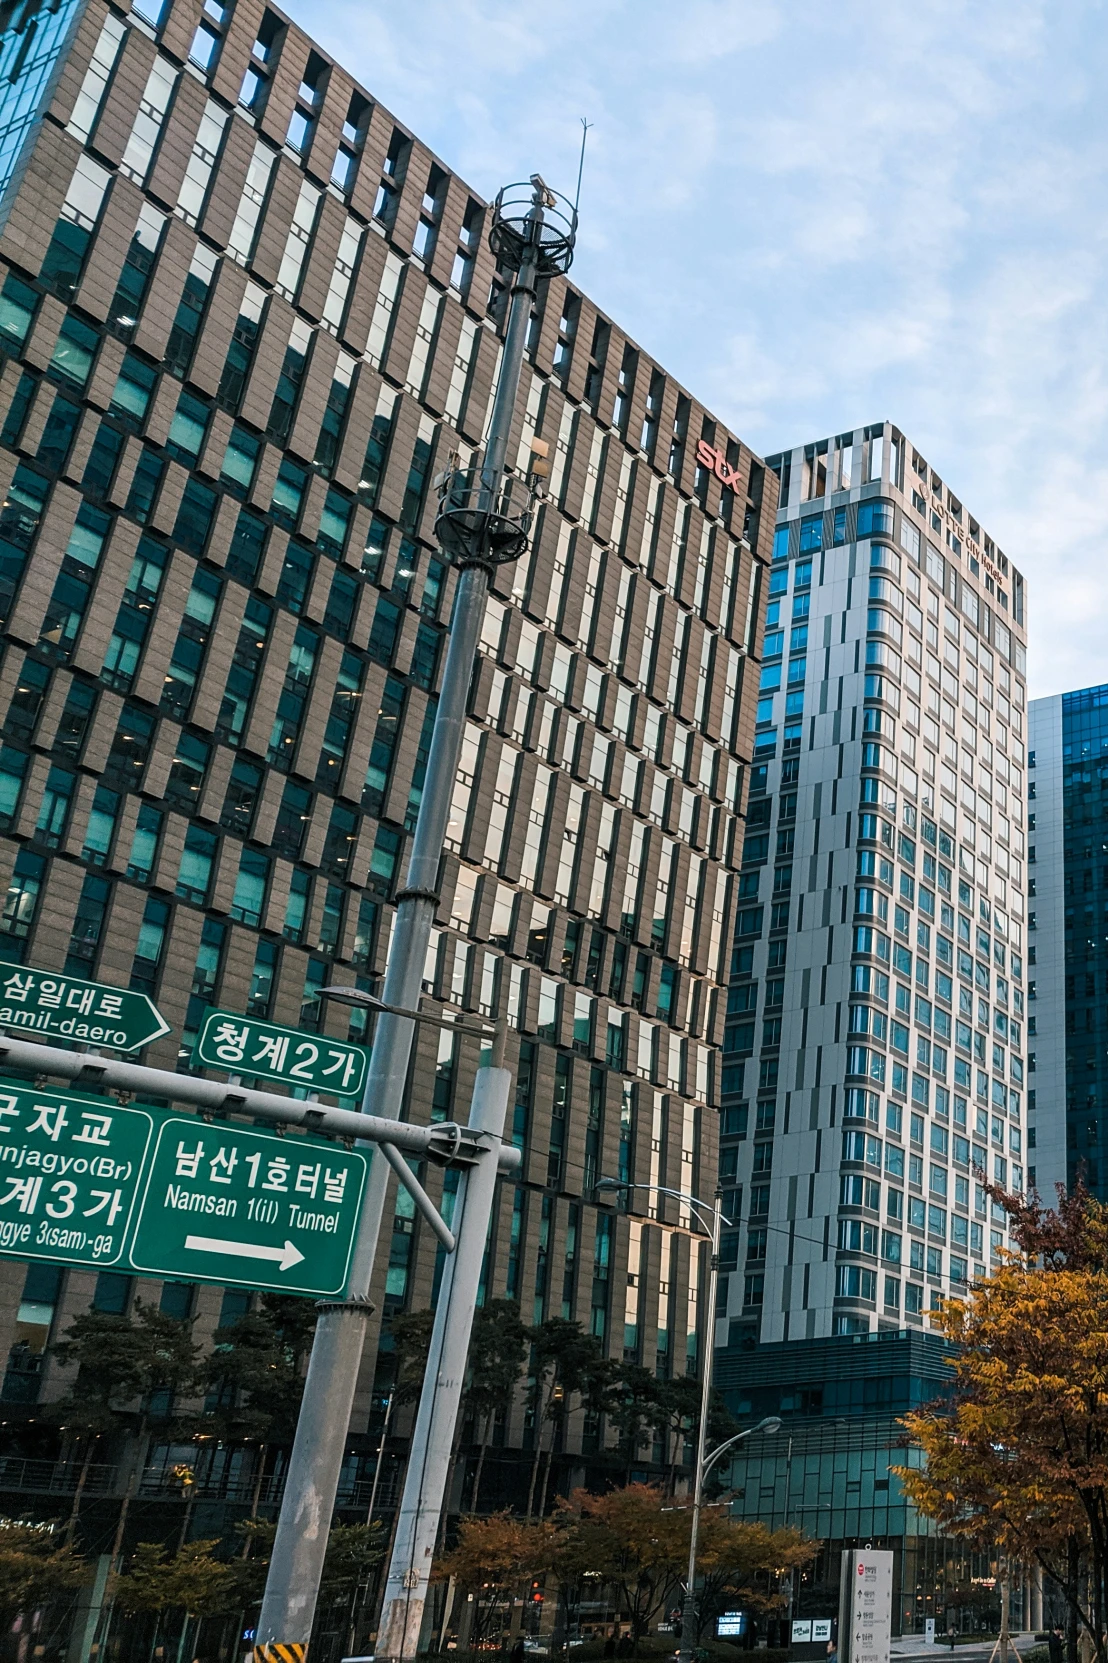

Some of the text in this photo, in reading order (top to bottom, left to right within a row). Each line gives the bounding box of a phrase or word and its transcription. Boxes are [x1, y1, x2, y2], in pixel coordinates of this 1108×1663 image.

[931, 495, 1003, 586] LOTTE City Hotels
[3, 972, 124, 1020] 삼일대로
[212, 1022, 356, 1088] 청계2가
[0, 1144, 132, 1181] njagyo(Br)
[175, 1141, 349, 1204] 남산1호터널
[164, 1183, 340, 1234] Namsan 1(il) Tunnel
[0, 1220, 114, 1259] gye 3(sam)-ga
